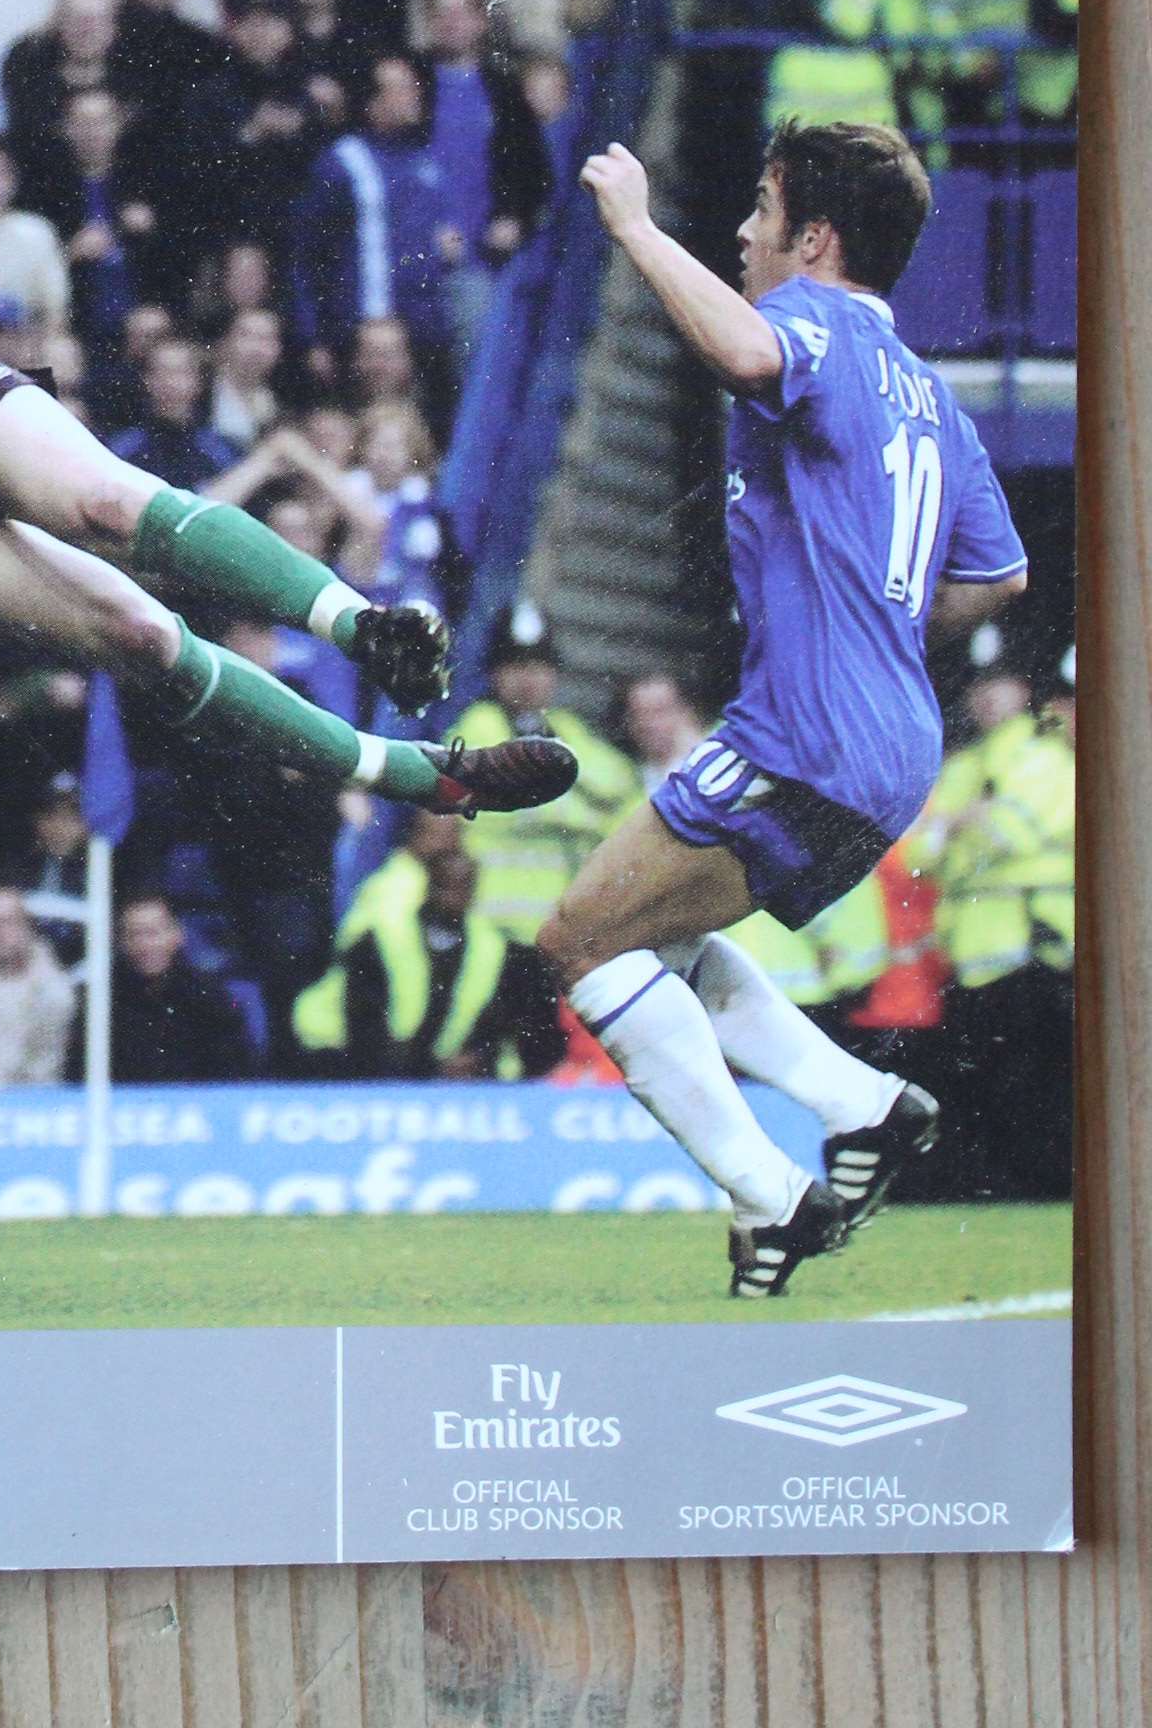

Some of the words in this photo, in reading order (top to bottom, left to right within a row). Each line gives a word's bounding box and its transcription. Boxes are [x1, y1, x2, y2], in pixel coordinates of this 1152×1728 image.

[882, 422, 944, 619] 10
[241, 1099, 532, 1145] FOOTBALL
[489, 1362, 562, 1411] Fly
[433, 1410, 622, 1450] Emirates
[453, 1478, 578, 1505] OFFICIAL
[782, 1475, 907, 1501] OFFICIAL
[407, 1508, 479, 1533] CLUB
[489, 1506, 624, 1532] SPONSOR
[679, 1504, 866, 1530] SPORTSWEAR
[875, 1502, 1010, 1528] SPONSOR
